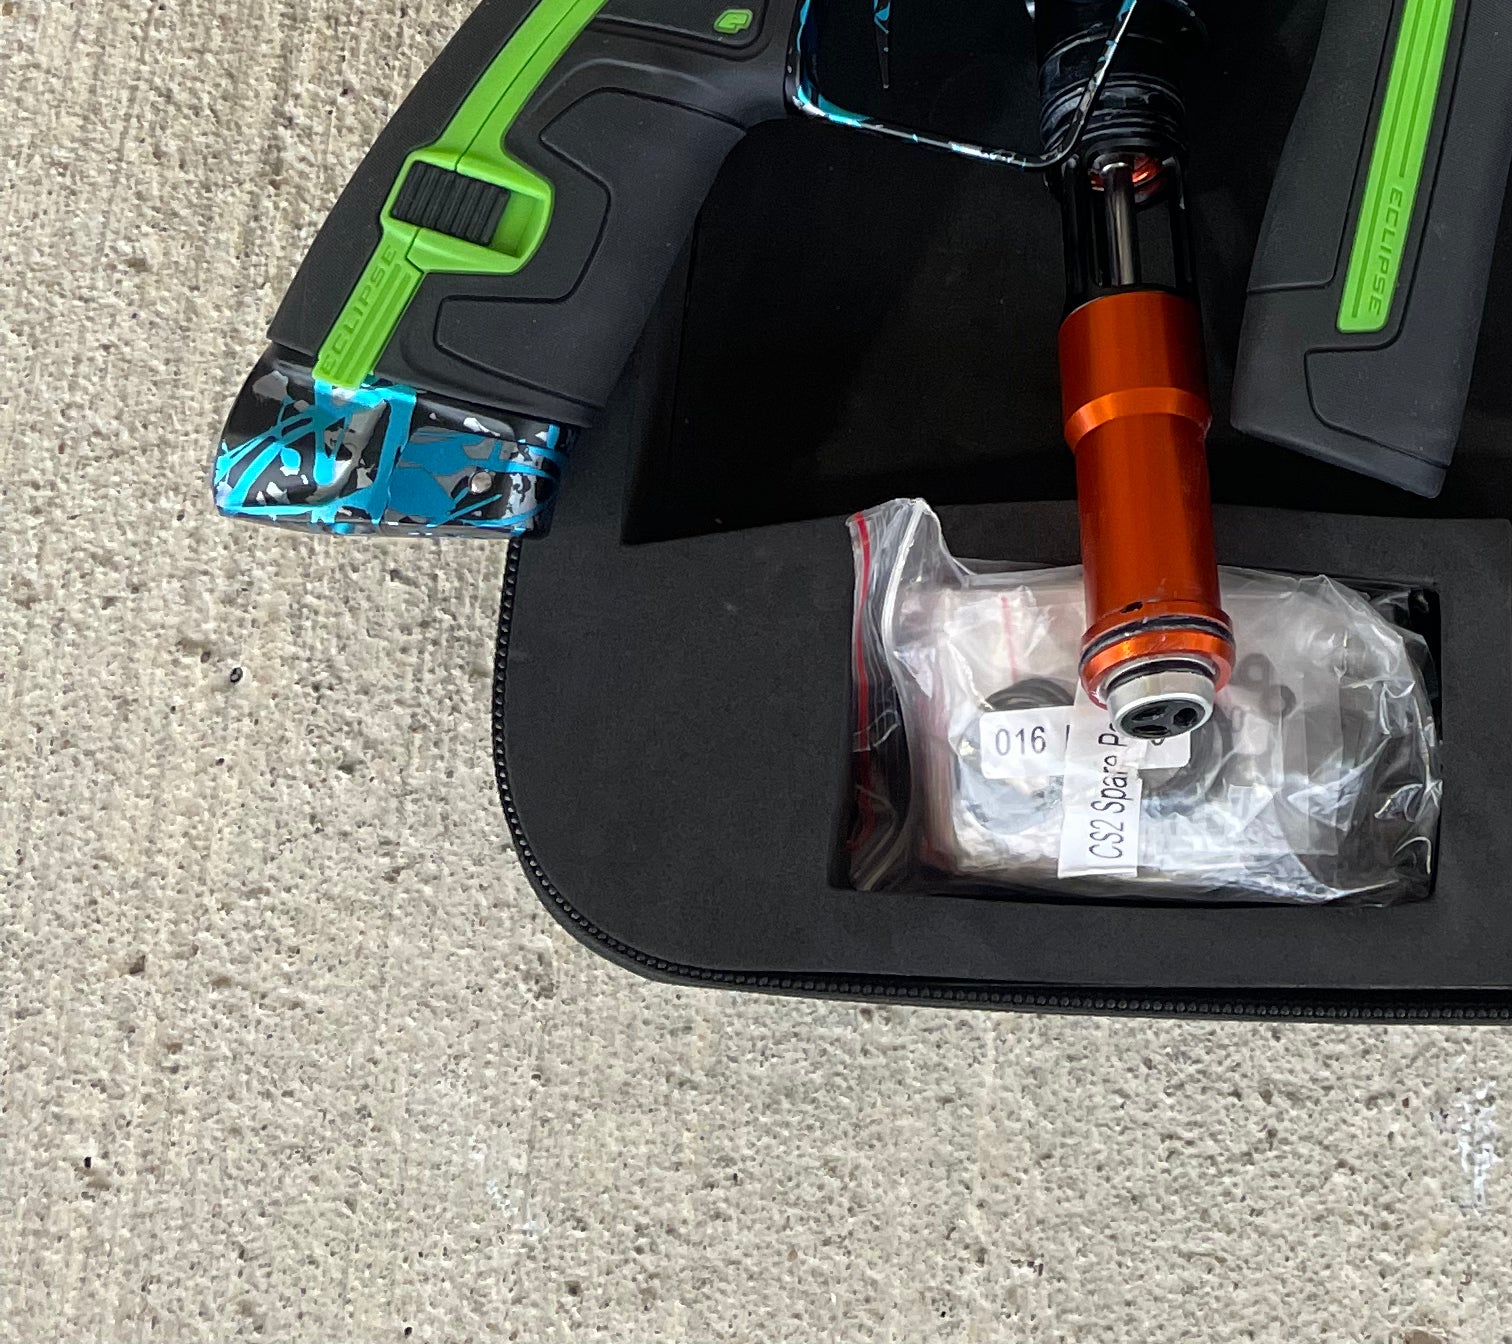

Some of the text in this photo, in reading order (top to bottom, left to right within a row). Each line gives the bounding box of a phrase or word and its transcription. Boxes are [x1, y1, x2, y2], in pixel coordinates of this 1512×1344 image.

[1369, 187, 1403, 315] ECLIPSE
[320, 244, 397, 376] ECLIPSE
[995, 725, 1046, 756] 016
[1089, 818, 1125, 859] CS2
